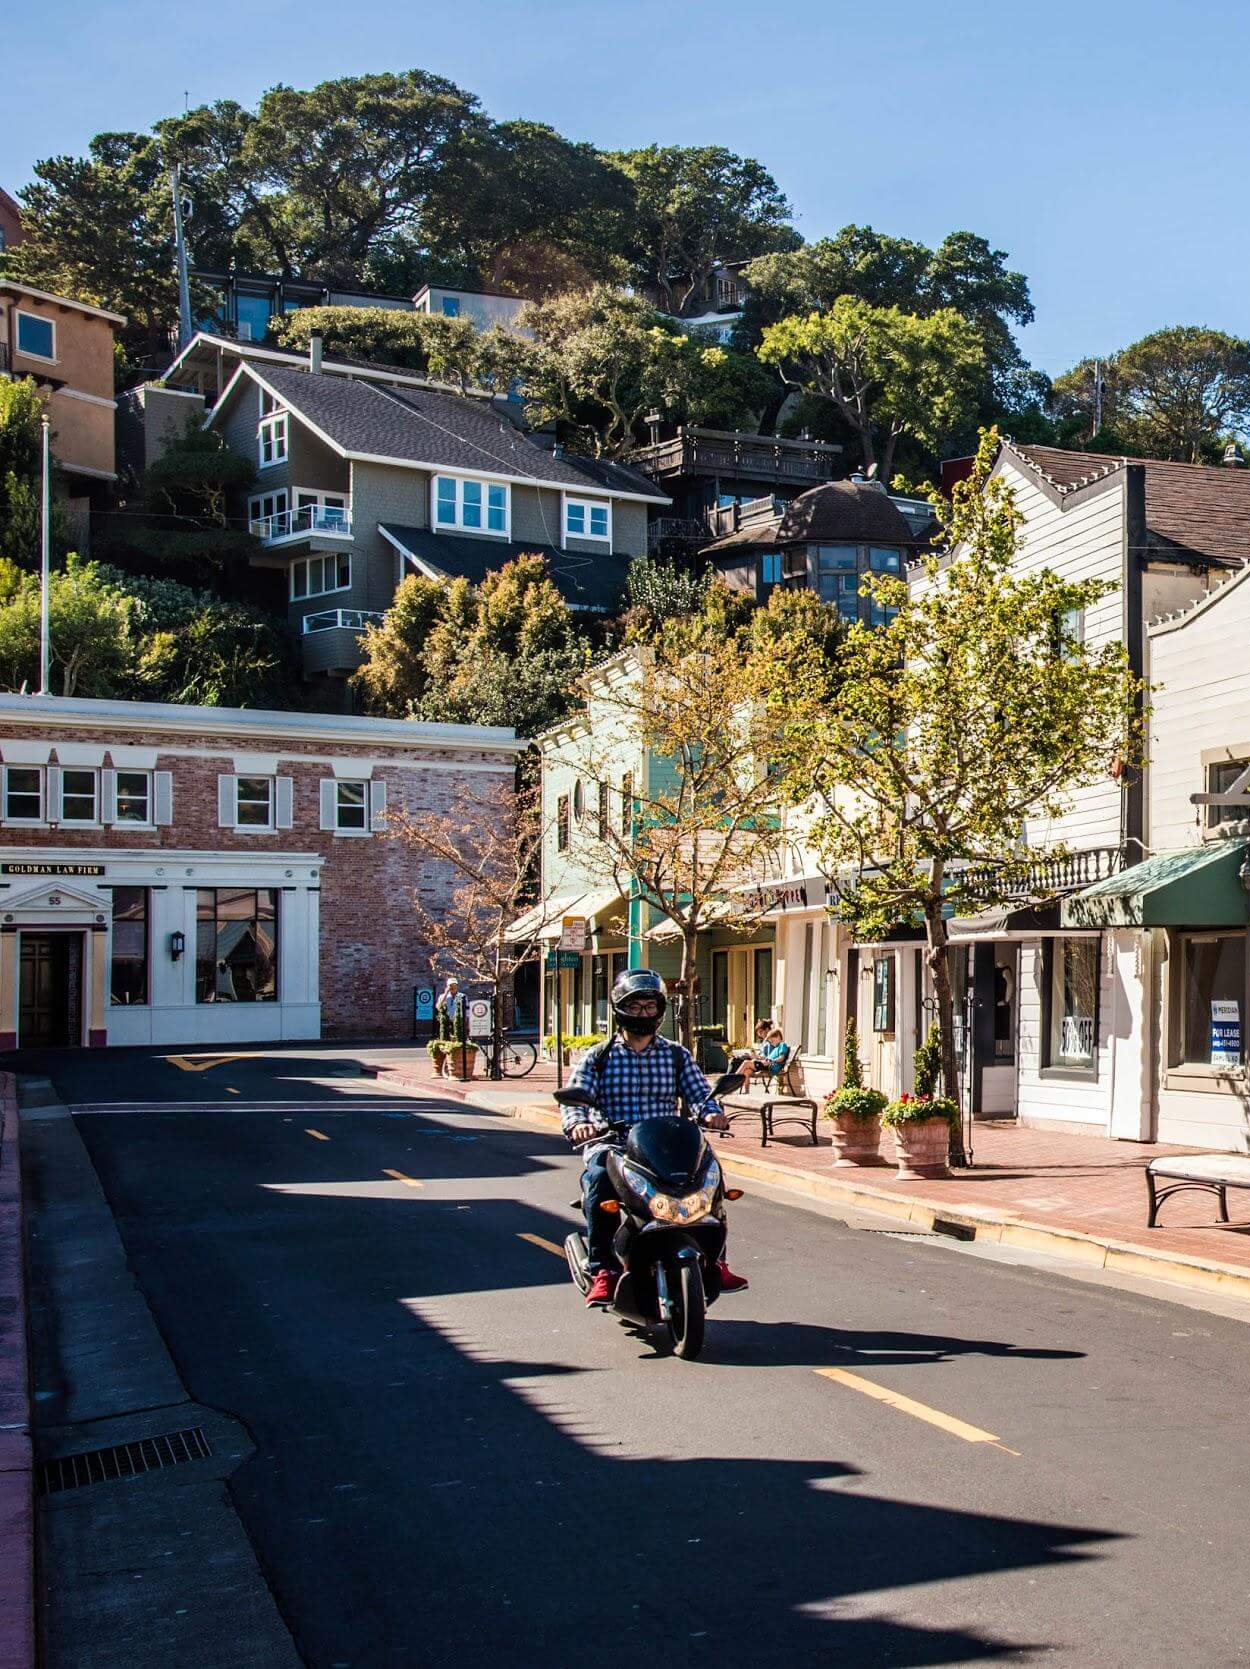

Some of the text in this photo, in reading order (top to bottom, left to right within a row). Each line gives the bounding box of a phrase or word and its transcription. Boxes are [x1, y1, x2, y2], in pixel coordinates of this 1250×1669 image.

[9, 865, 99, 875] GOLDMAN LAW FIRM
[49, 896, 61, 905] 55
[1219, 1006, 1239, 1014] MERIDIAN
[1212, 1028, 1240, 1038] FOR LEASE
